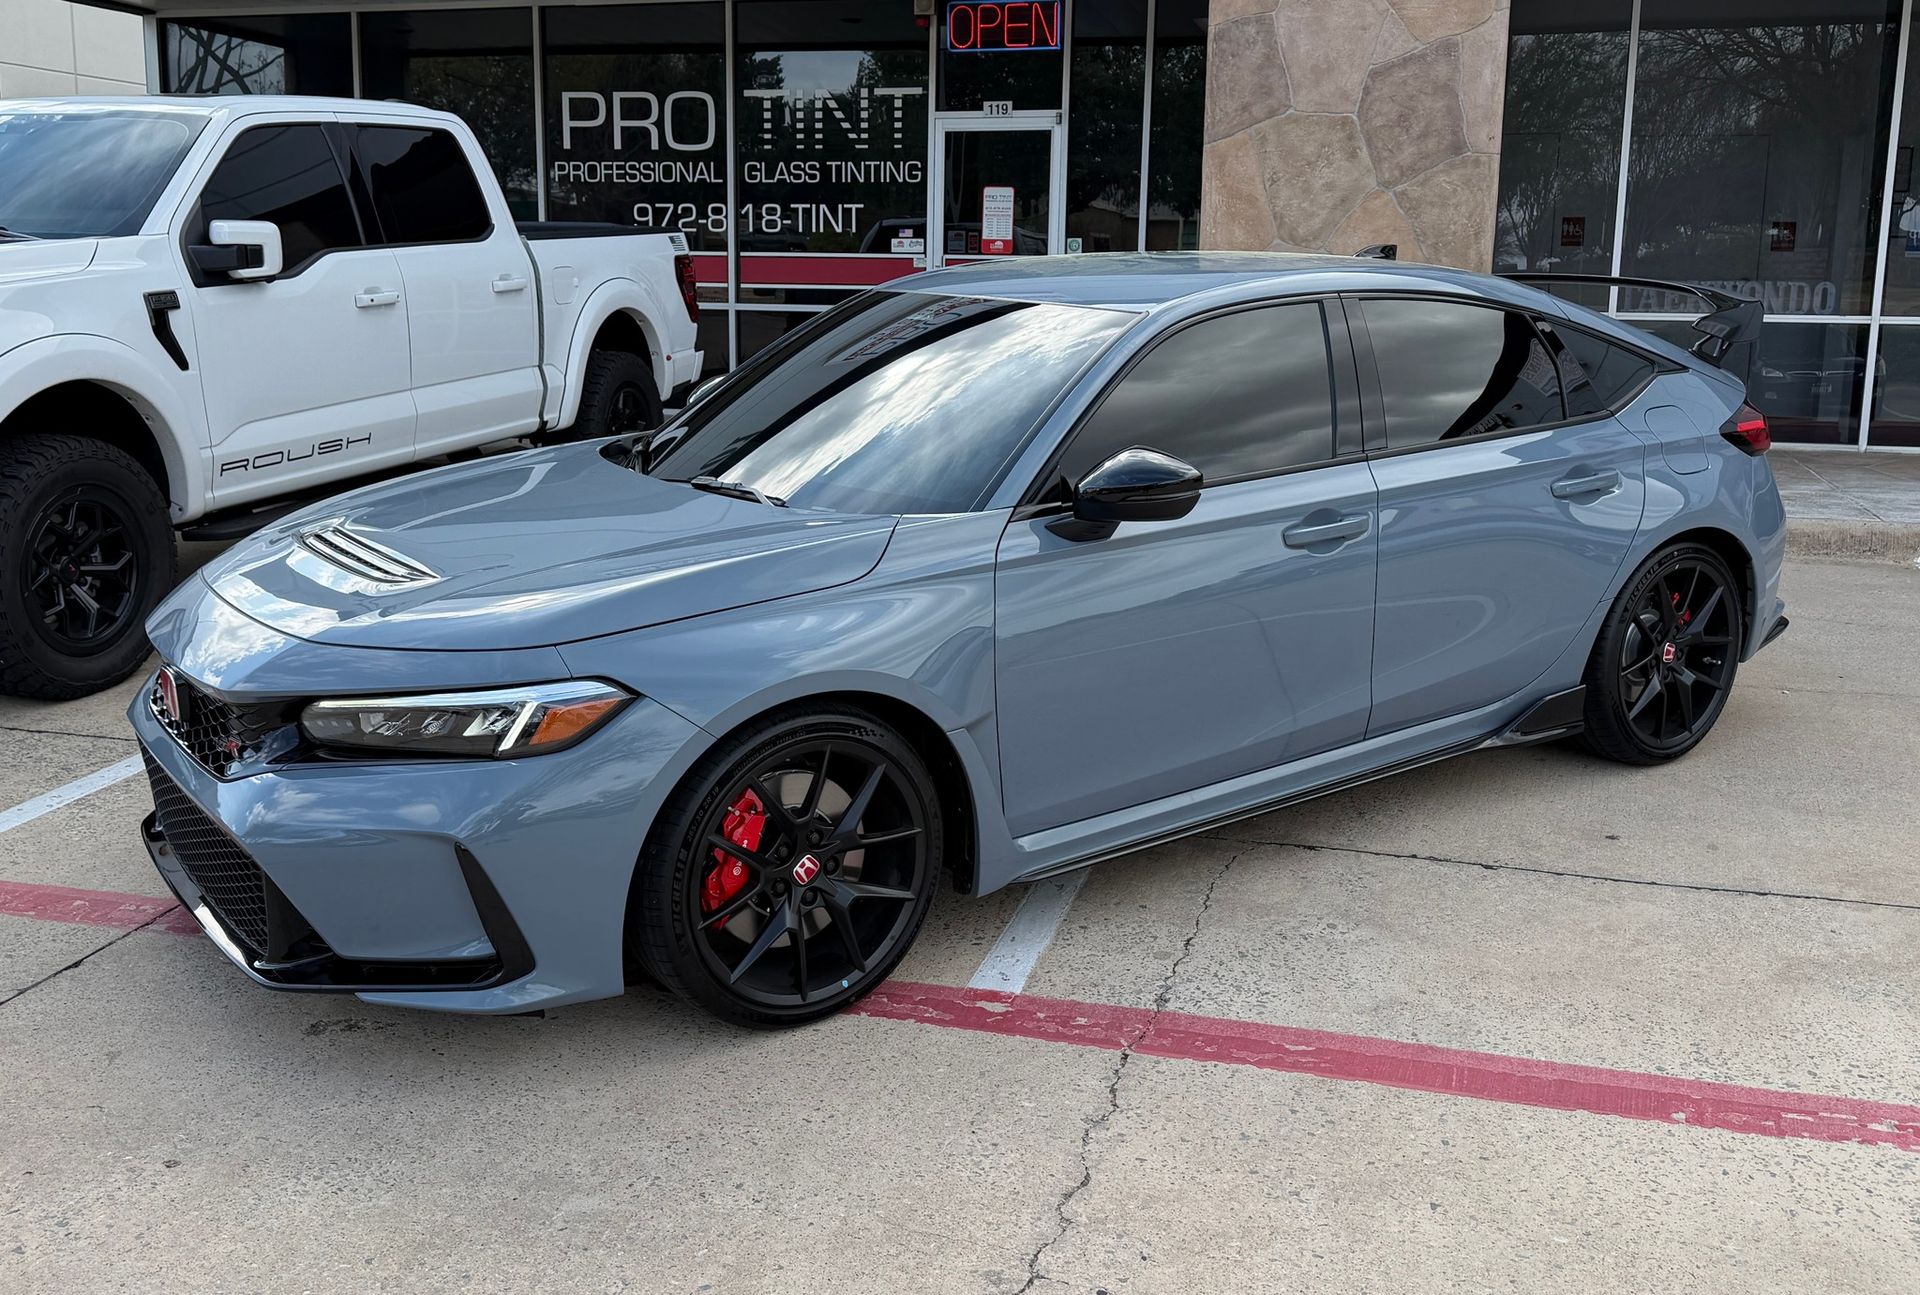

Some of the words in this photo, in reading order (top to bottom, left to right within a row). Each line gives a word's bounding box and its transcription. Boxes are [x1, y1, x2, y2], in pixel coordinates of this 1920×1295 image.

[950, 2, 1058, 49] OPEN
[561, 90, 716, 151] PRO
[743, 87, 923, 149] TINT
[988, 103, 1009, 115] 119
[554, 161, 724, 183] PROFESSIONAL
[744, 161, 821, 183] GLASS
[826, 160, 922, 183] TINTING
[220, 432, 372, 477] ROUSH
[672, 847, 689, 936] MICHELIN
